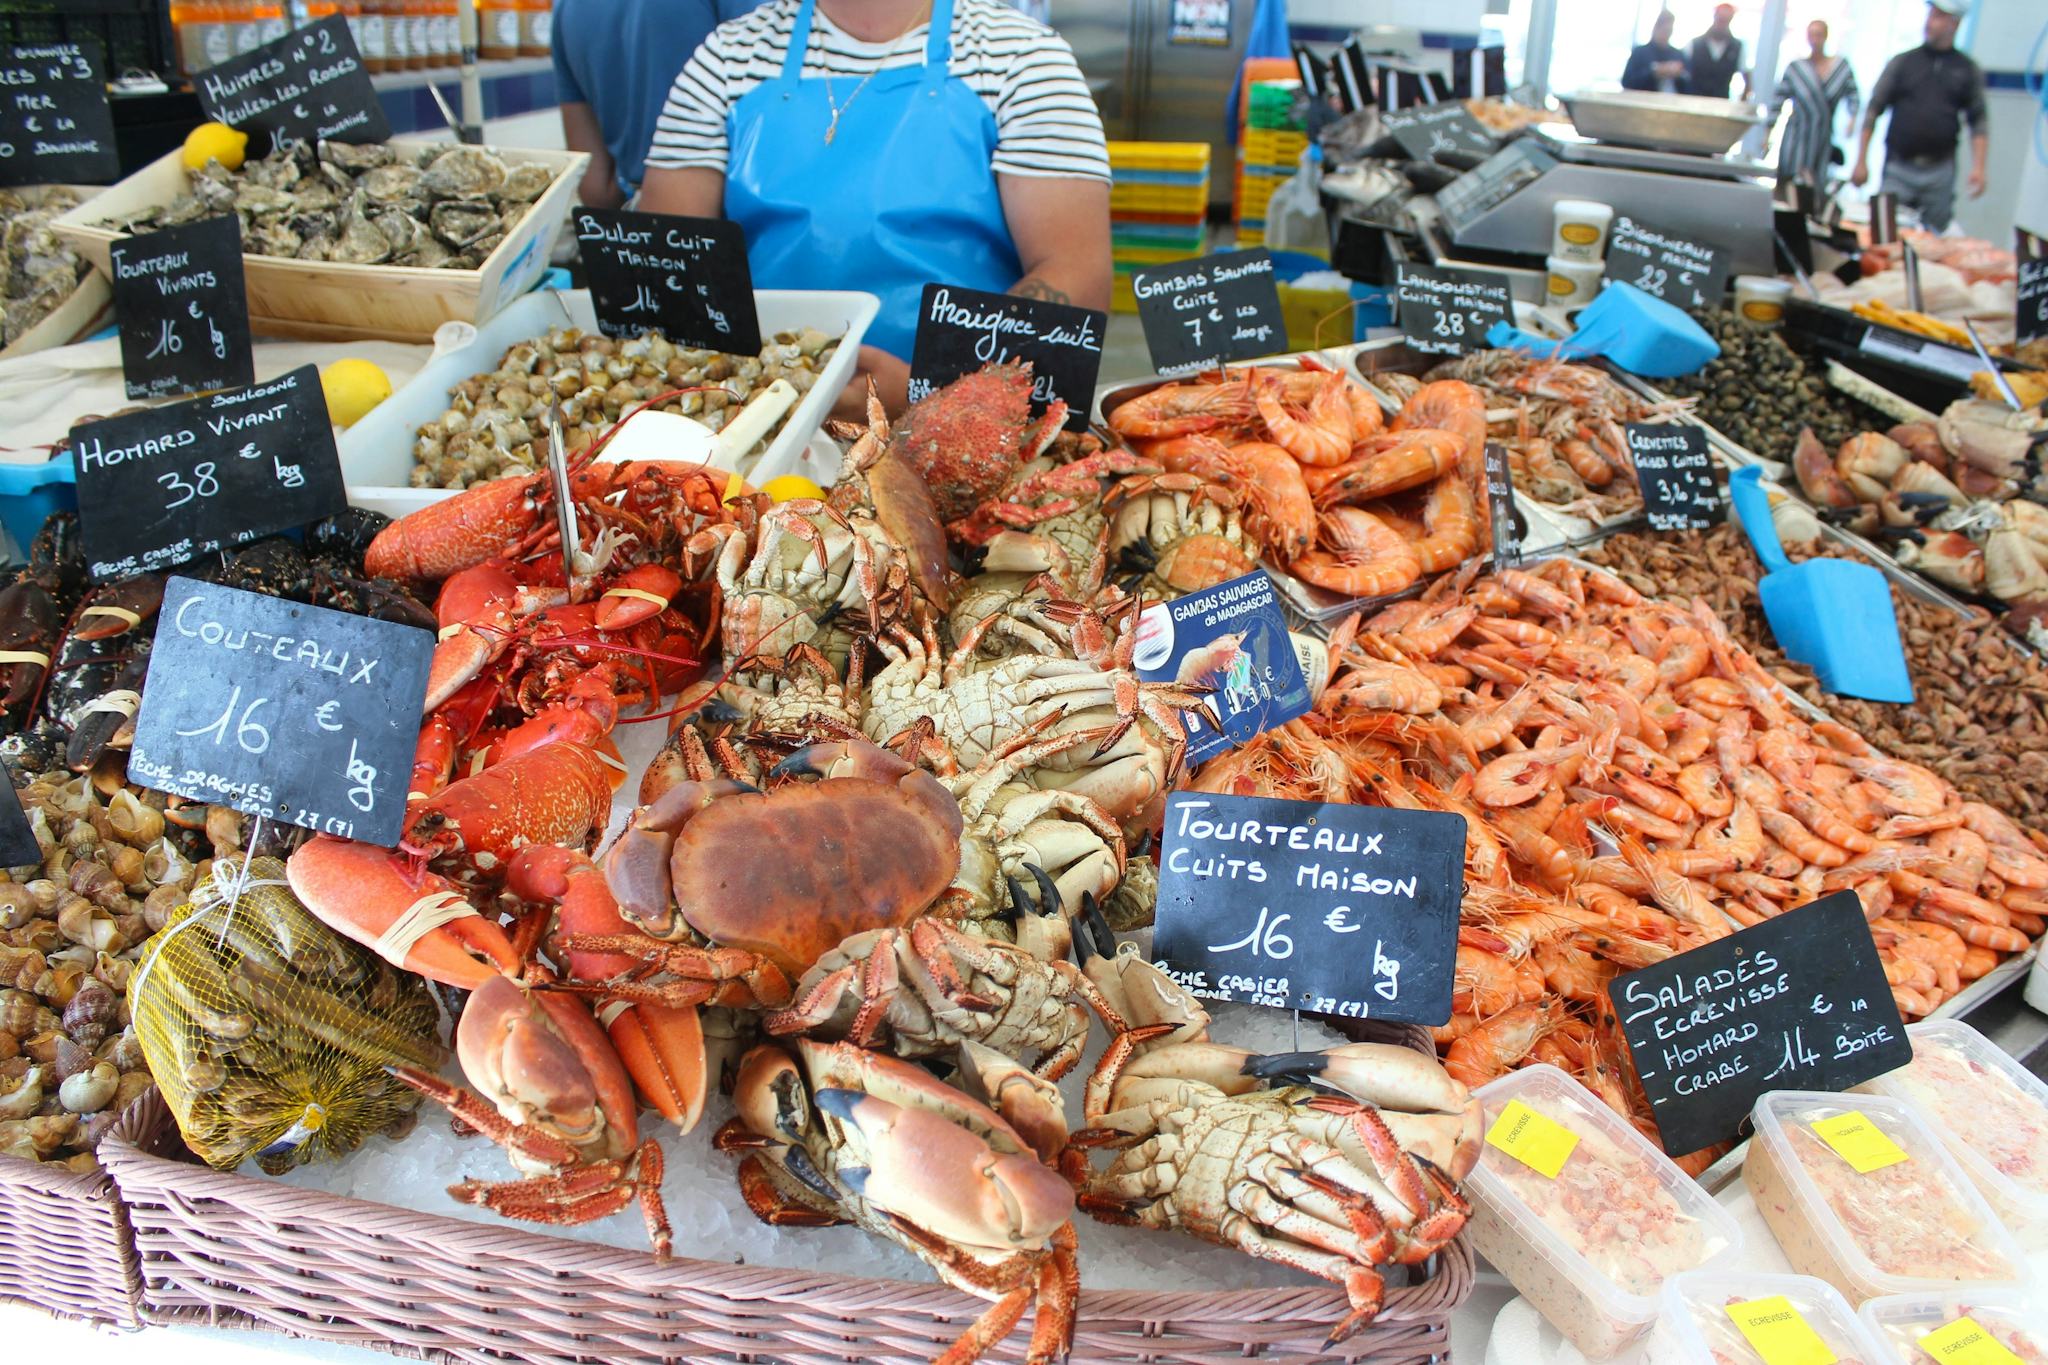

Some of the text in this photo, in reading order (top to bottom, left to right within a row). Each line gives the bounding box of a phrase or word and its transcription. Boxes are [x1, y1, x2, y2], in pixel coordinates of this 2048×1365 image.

[73, 57, 93, 79] 3
[204, 58, 286, 103] HUITRES
[318, 29, 336, 54] 2
[294, 104, 309, 118] €
[578, 215, 716, 252] BULOT CUIT
[112, 249, 189, 279] TOURTEAUX
[1133, 259, 1272, 300] GAMBAS SAUVAGE
[1633, 263, 1668, 297] 22
[156, 271, 217, 296] VIVANTS
[665, 275, 683, 291] €
[1397, 263, 1508, 301] LANGOUSTINE
[188, 301, 203, 318] €
[621, 284, 731, 334] 14 kg
[1172, 291, 1219, 310] CUITE
[1207, 304, 1258, 322] € LES
[1468, 311, 1484, 325] €
[146, 317, 226, 360] 16 kg
[1183, 318, 1203, 347] 7
[211, 376, 297, 408] BOULOGNE
[79, 404, 288, 474] HOMARD VIVANT
[239, 442, 262, 459] €
[156, 455, 305, 509] 38 kg
[142, 537, 193, 563] CASIER
[1173, 576, 1269, 622] GAMBAS SAUVAGES
[1204, 591, 1273, 627] de MADAGASCAR
[175, 596, 378, 685] COUTEAUX
[1264, 665, 1275, 682] €
[175, 685, 378, 812] 16 € kg
[153, 779, 201, 801] ZONE
[239, 800, 274, 819] FAO
[1175, 800, 1384, 855] TOURTEAUX
[1168, 848, 1418, 899] CUITS MAISON
[1207, 906, 1400, 1001] 16 € kg
[1218, 975, 1290, 999] CASIER
[1250, 992, 1286, 1009] FAO
[1625, 950, 1778, 1024] SALADES
[1654, 973, 1790, 1040] ECREVISSE
[1809, 993, 1833, 1015] €
[1663, 1022, 1894, 1081] HOMARD 14 BOITE
[1674, 1055, 1750, 1096] CRABE
[1506, 1112, 1531, 1144] ECREVISSE
[1747, 1311, 1793, 1327] ECREVISSE
[1941, 1332, 1983, 1355] ECREVISSE
